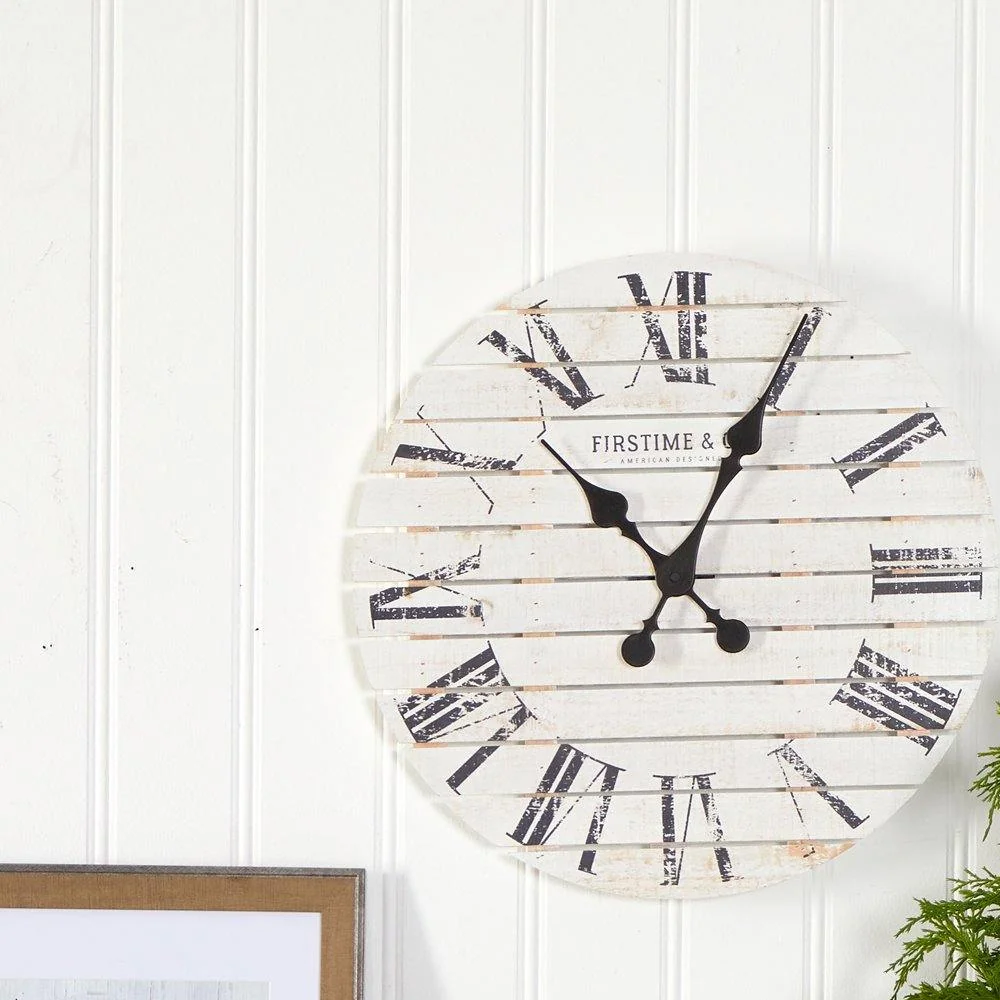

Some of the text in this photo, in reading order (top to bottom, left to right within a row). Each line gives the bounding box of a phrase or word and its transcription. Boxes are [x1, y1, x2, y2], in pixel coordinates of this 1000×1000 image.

[478, 299, 605, 439] XI
[617, 271, 716, 388] XII
[391, 405, 523, 515] X
[592, 433, 693, 453] FIRSTIME
[701, 432, 714, 450] &
[620, 456, 670, 464] AMERICAN
[831, 402, 947, 494] II
[869, 543, 983, 603] III
[653, 772, 744, 886] VI
